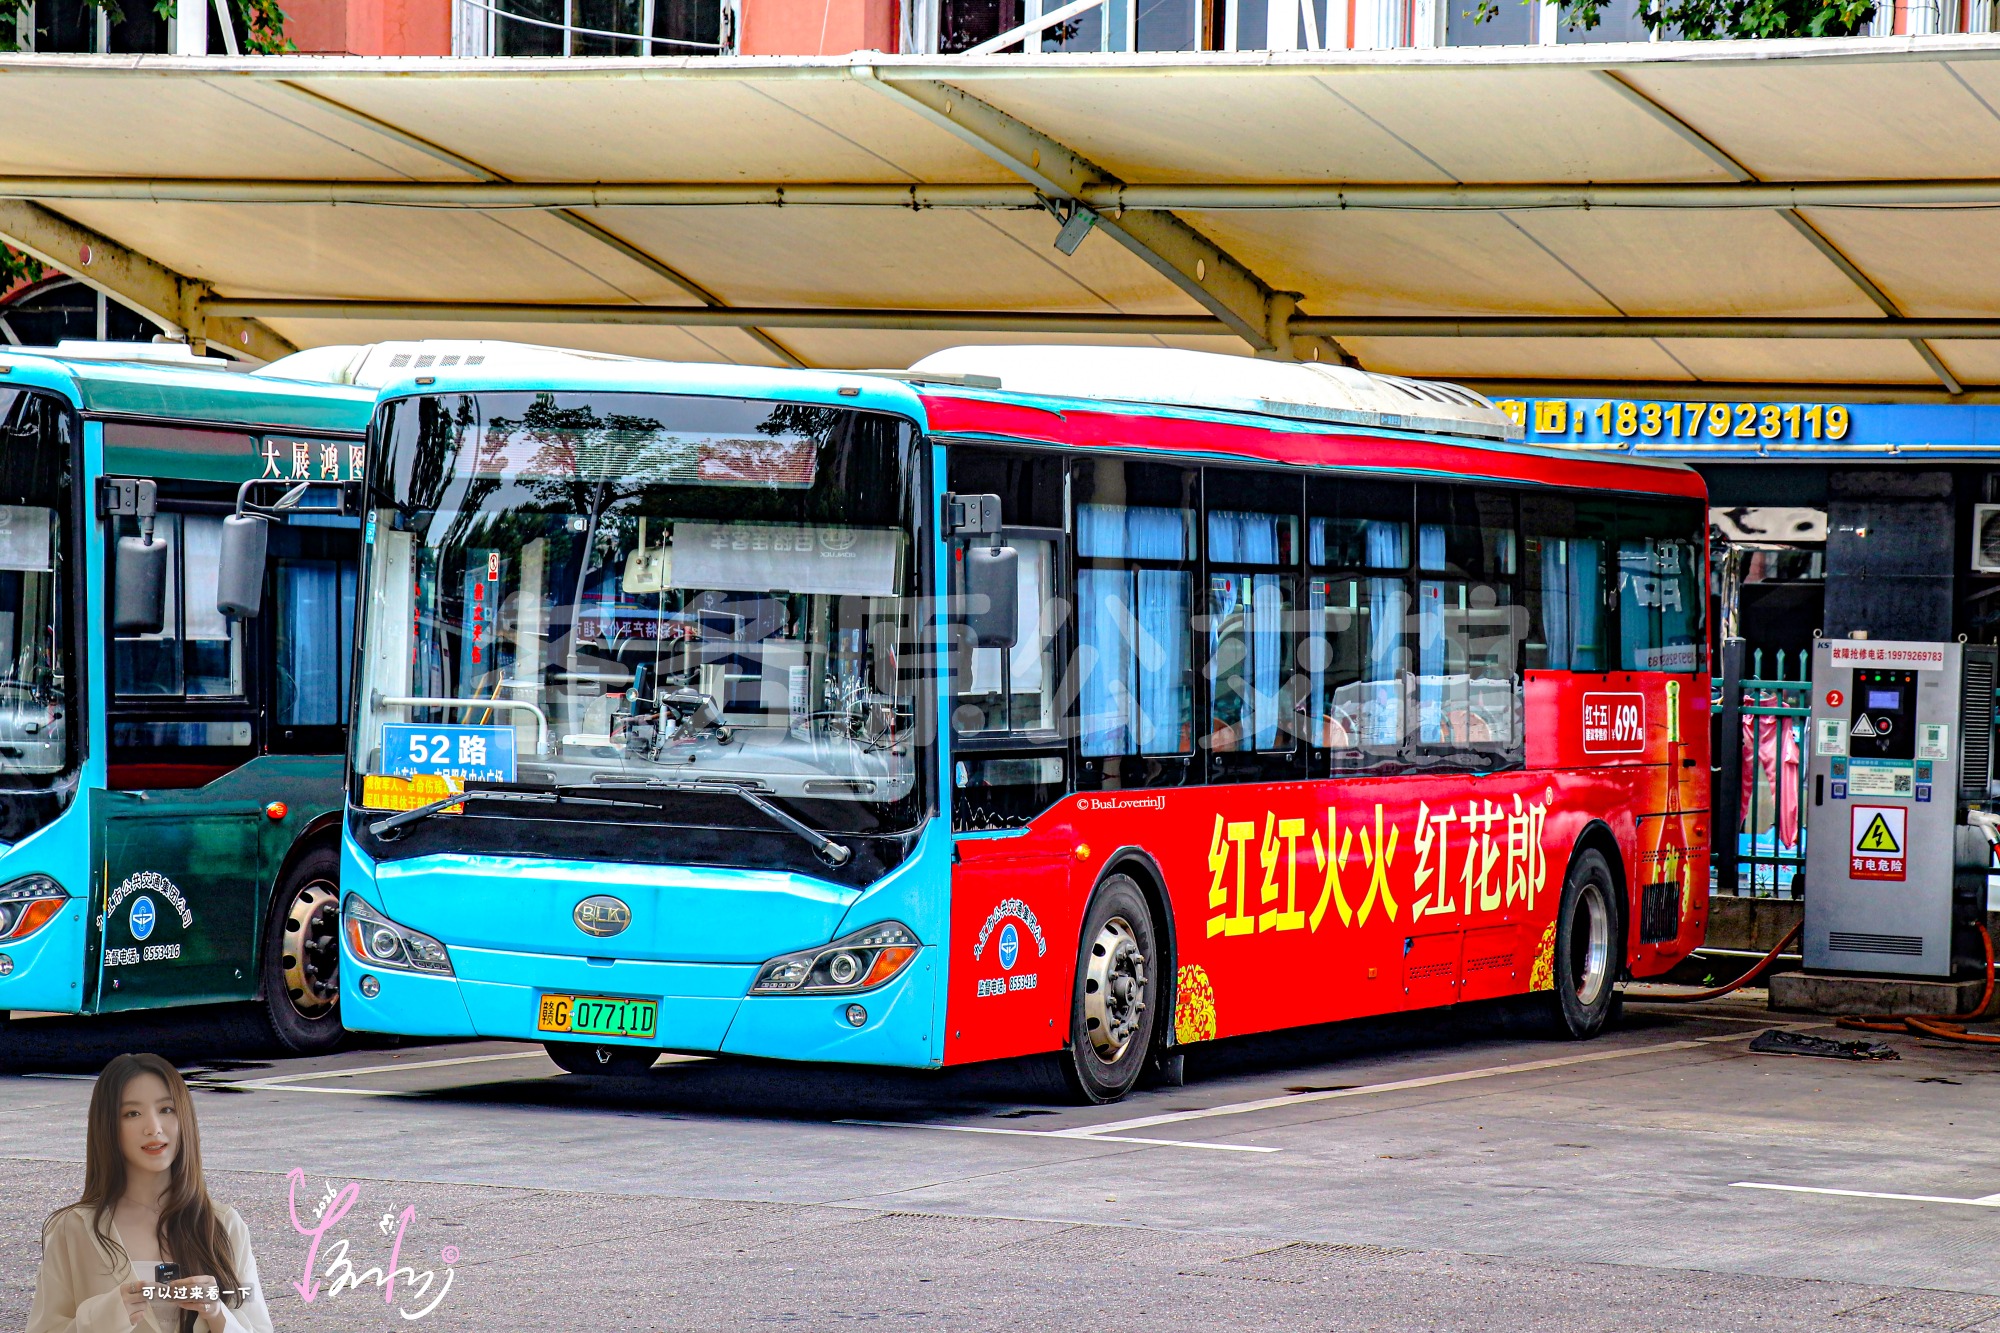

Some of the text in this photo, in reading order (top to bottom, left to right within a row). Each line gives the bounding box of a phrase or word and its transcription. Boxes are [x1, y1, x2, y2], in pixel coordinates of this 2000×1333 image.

[262, 440, 366, 481] 大展鸿图
[1830, 693, 1839, 705] 2
[1585, 704, 1608, 727] 红十五
[1206, 803, 1400, 938] 红红火火
[1852, 858, 1903, 872] 有电危险
[142, 944, 181, 961] 8553416
[1008, 973, 1037, 991] 8553416
